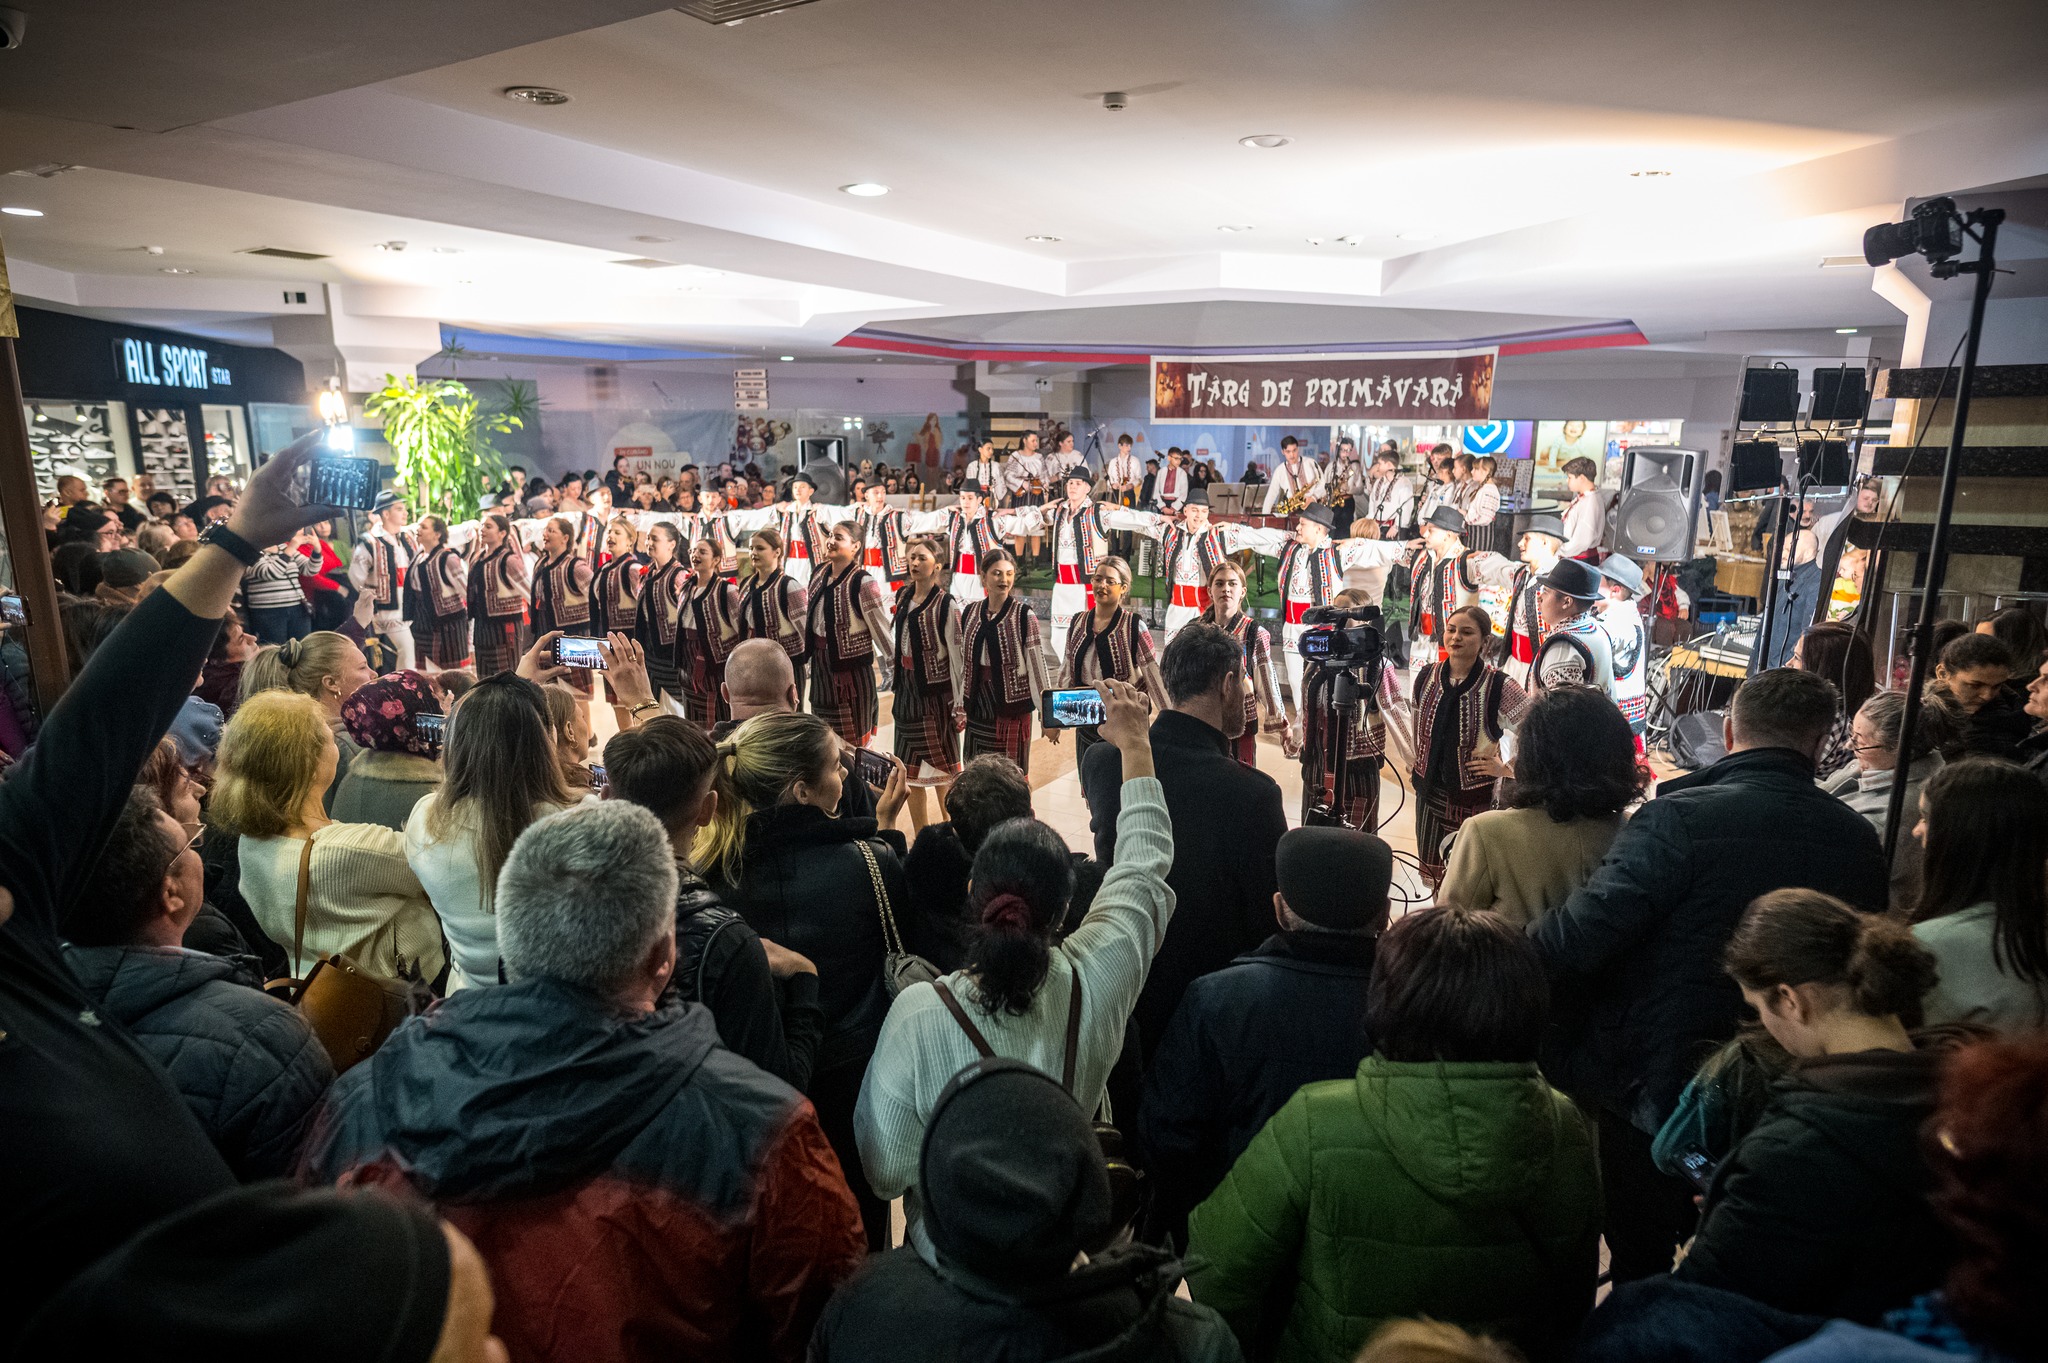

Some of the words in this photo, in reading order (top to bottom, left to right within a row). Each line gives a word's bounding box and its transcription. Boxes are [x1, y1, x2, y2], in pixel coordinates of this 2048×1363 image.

[123, 338, 160, 385] ALL
[161, 344, 208, 389] SPORT
[211, 367, 231, 385] STAR
[1187, 372, 1250, 408] TÂRG
[1261, 379, 1293, 407] DE
[637, 460, 652, 470] UN
[654, 459, 676, 469] NOU
